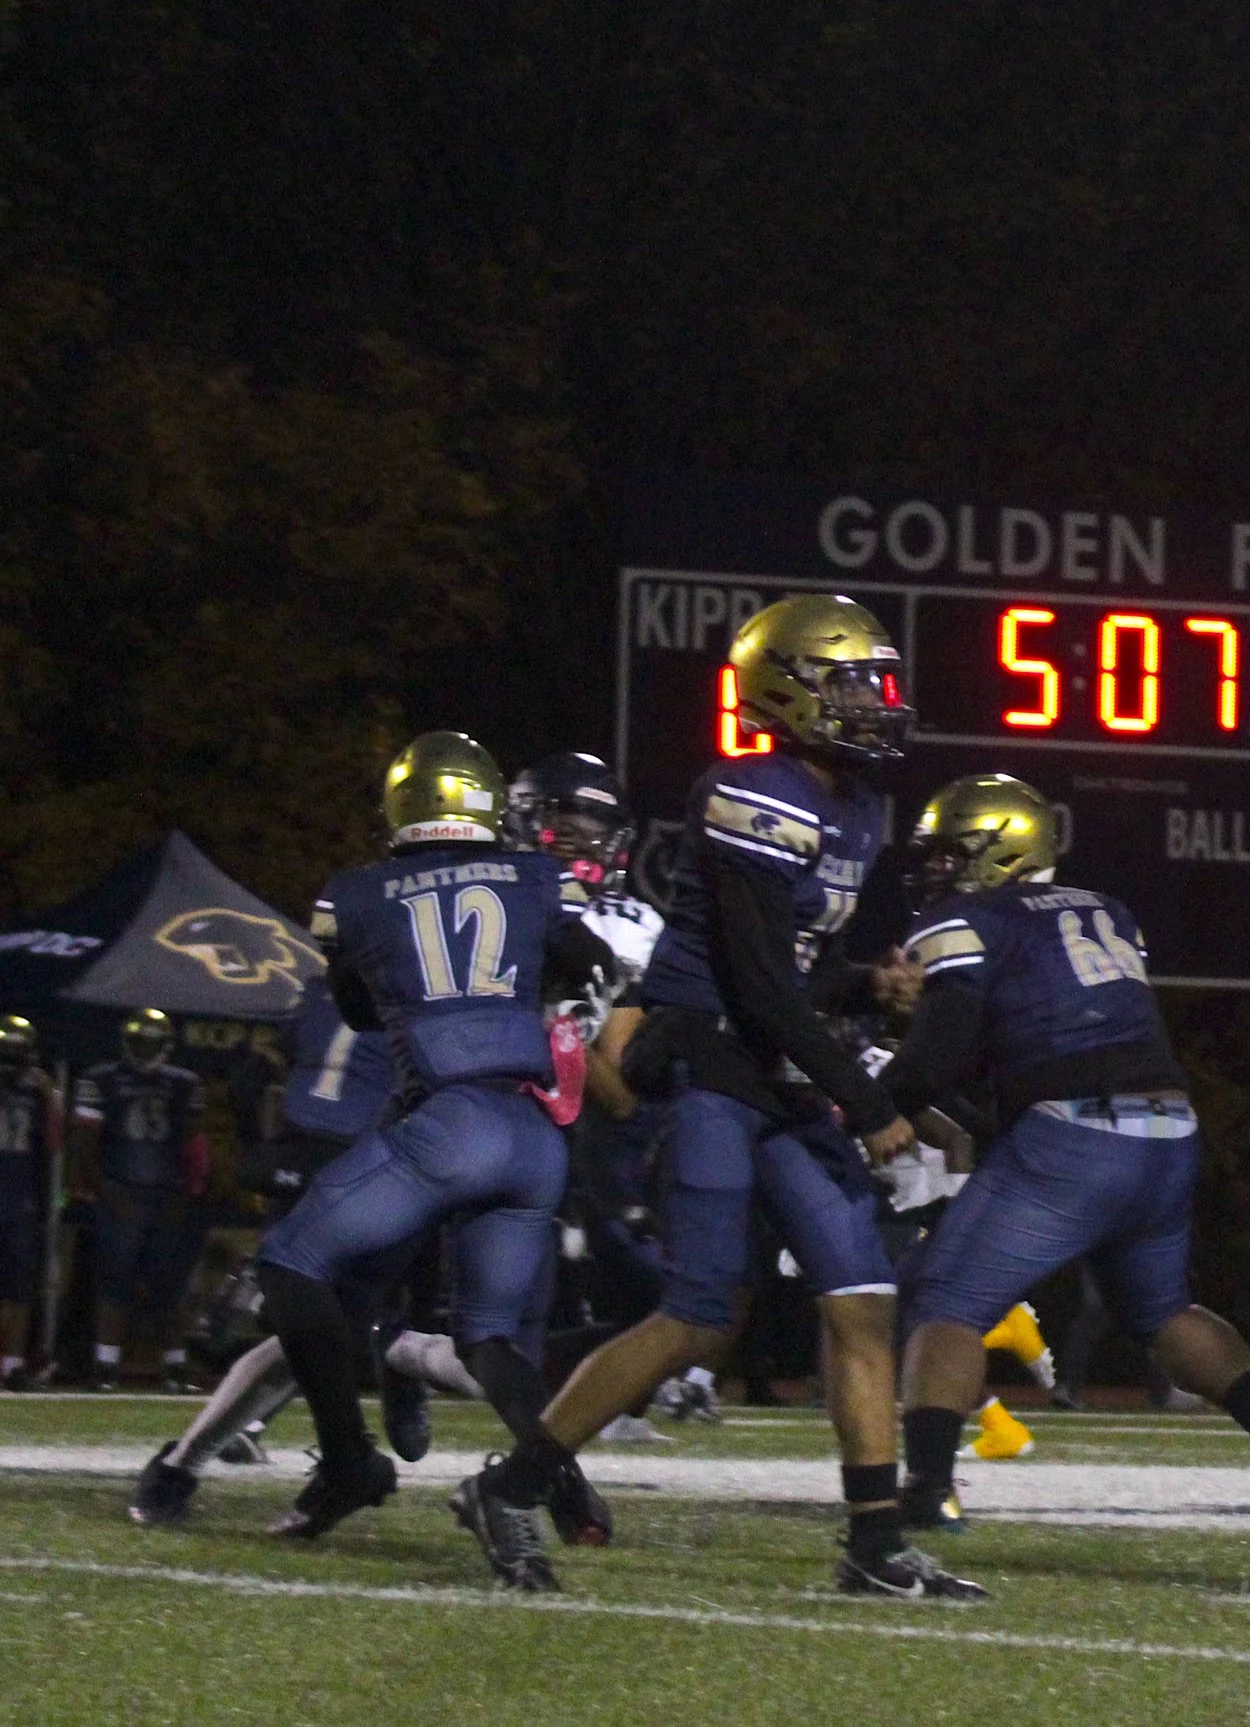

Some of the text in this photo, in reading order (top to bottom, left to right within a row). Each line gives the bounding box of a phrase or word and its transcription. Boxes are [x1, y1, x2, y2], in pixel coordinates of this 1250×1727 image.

[818, 496, 1167, 586] GOLDEN
[409, 826, 475, 841] Riddell
[400, 884, 518, 1001] 12
